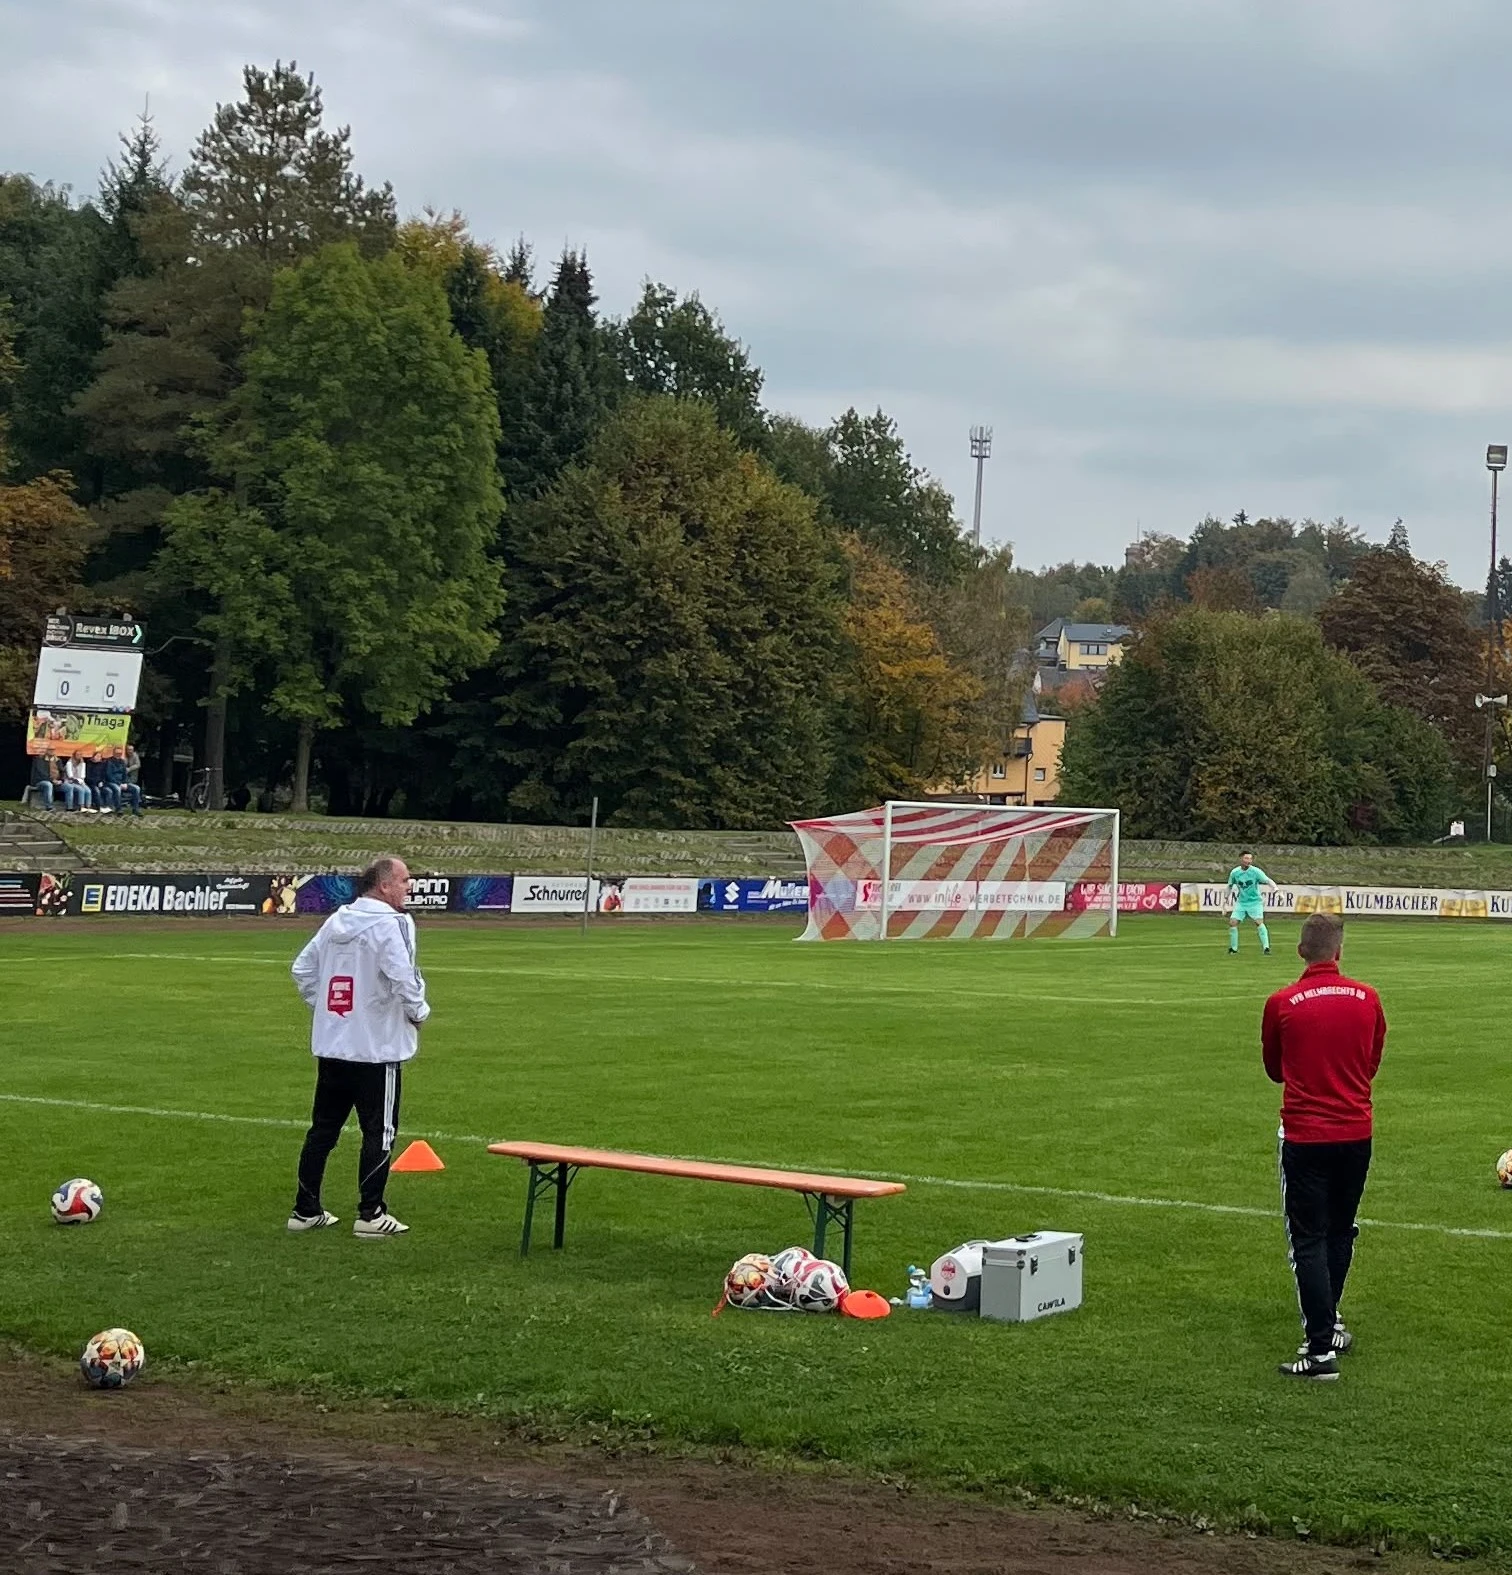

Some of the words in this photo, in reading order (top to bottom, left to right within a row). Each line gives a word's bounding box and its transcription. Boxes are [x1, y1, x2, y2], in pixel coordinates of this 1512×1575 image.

[60, 680, 70, 696] 0
[106, 683, 115, 698] 0
[105, 886, 159, 910] EDEKA
[162, 885, 228, 910] Bachler
[1345, 891, 1438, 911] KULMBACHER
[1303, 986, 1356, 999] HELMBRECHTS
